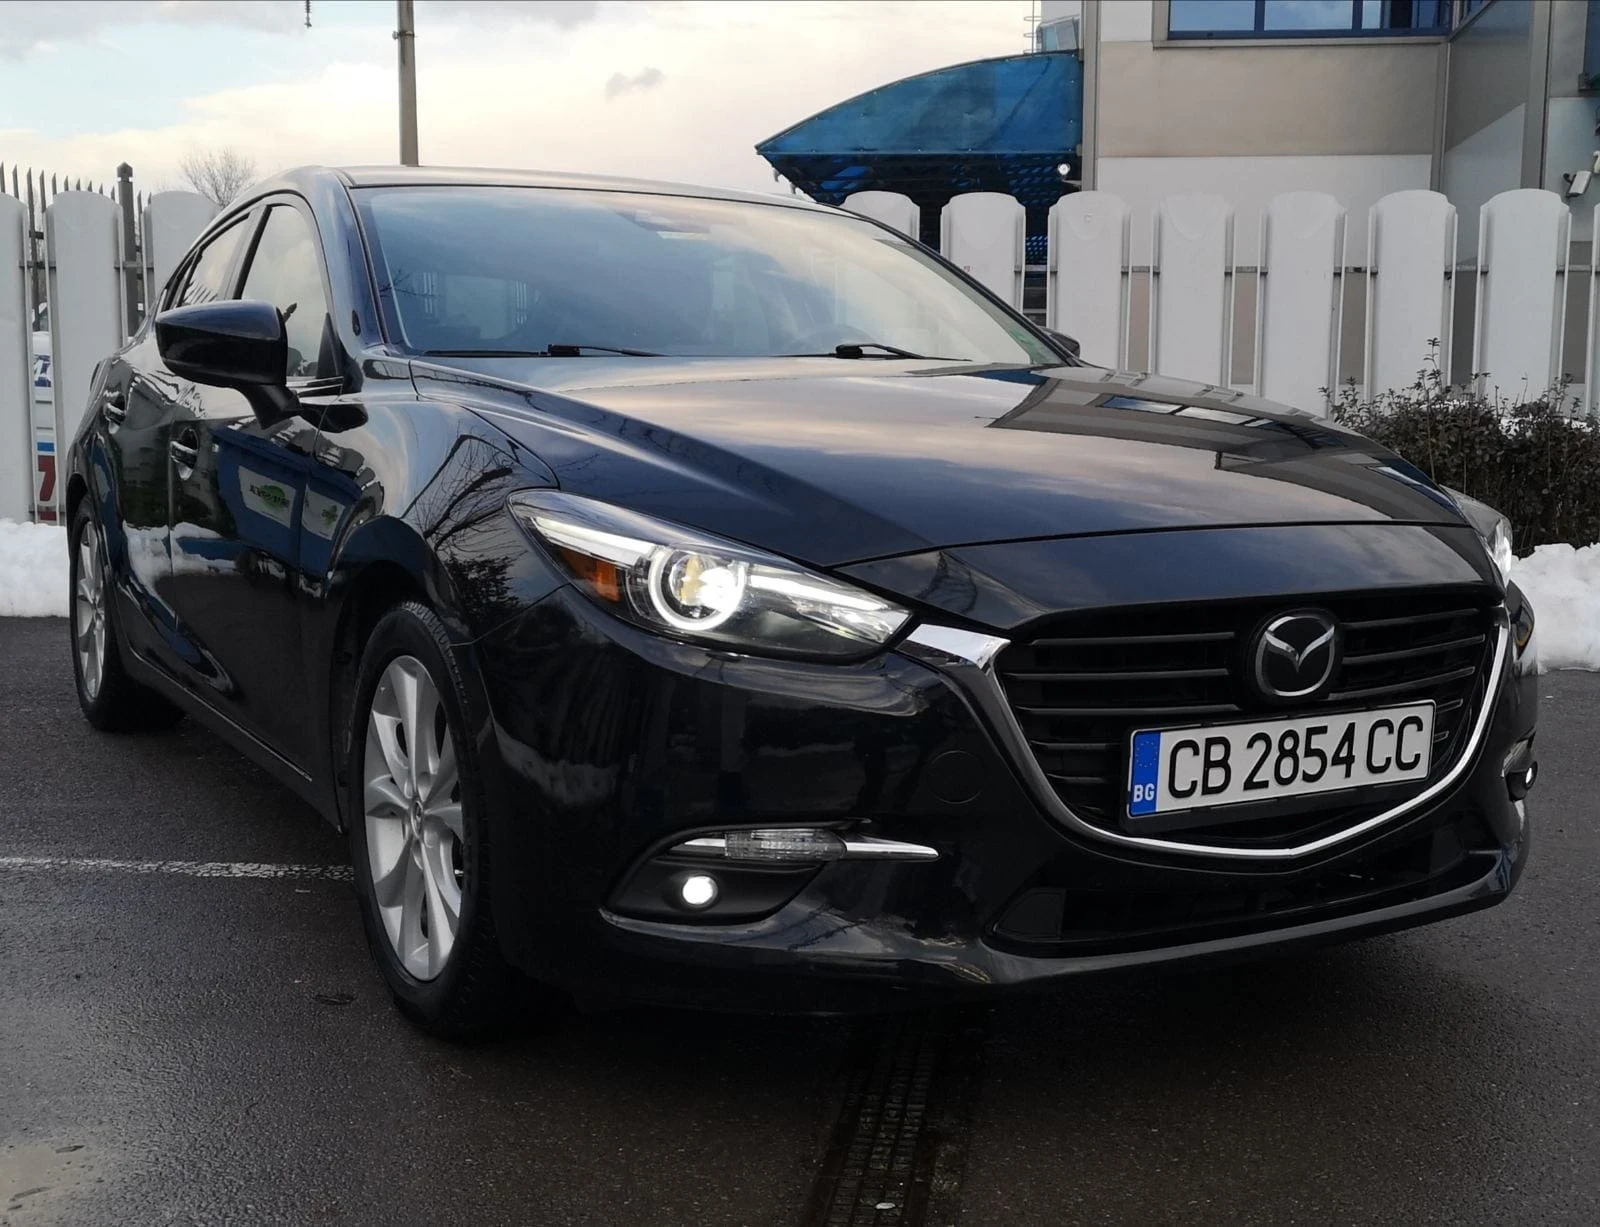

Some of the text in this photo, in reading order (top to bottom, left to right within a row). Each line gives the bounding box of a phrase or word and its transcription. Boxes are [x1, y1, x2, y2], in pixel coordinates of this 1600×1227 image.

[1167, 715, 1424, 799] CB 2854 CC
[1133, 783, 1155, 802] BG
